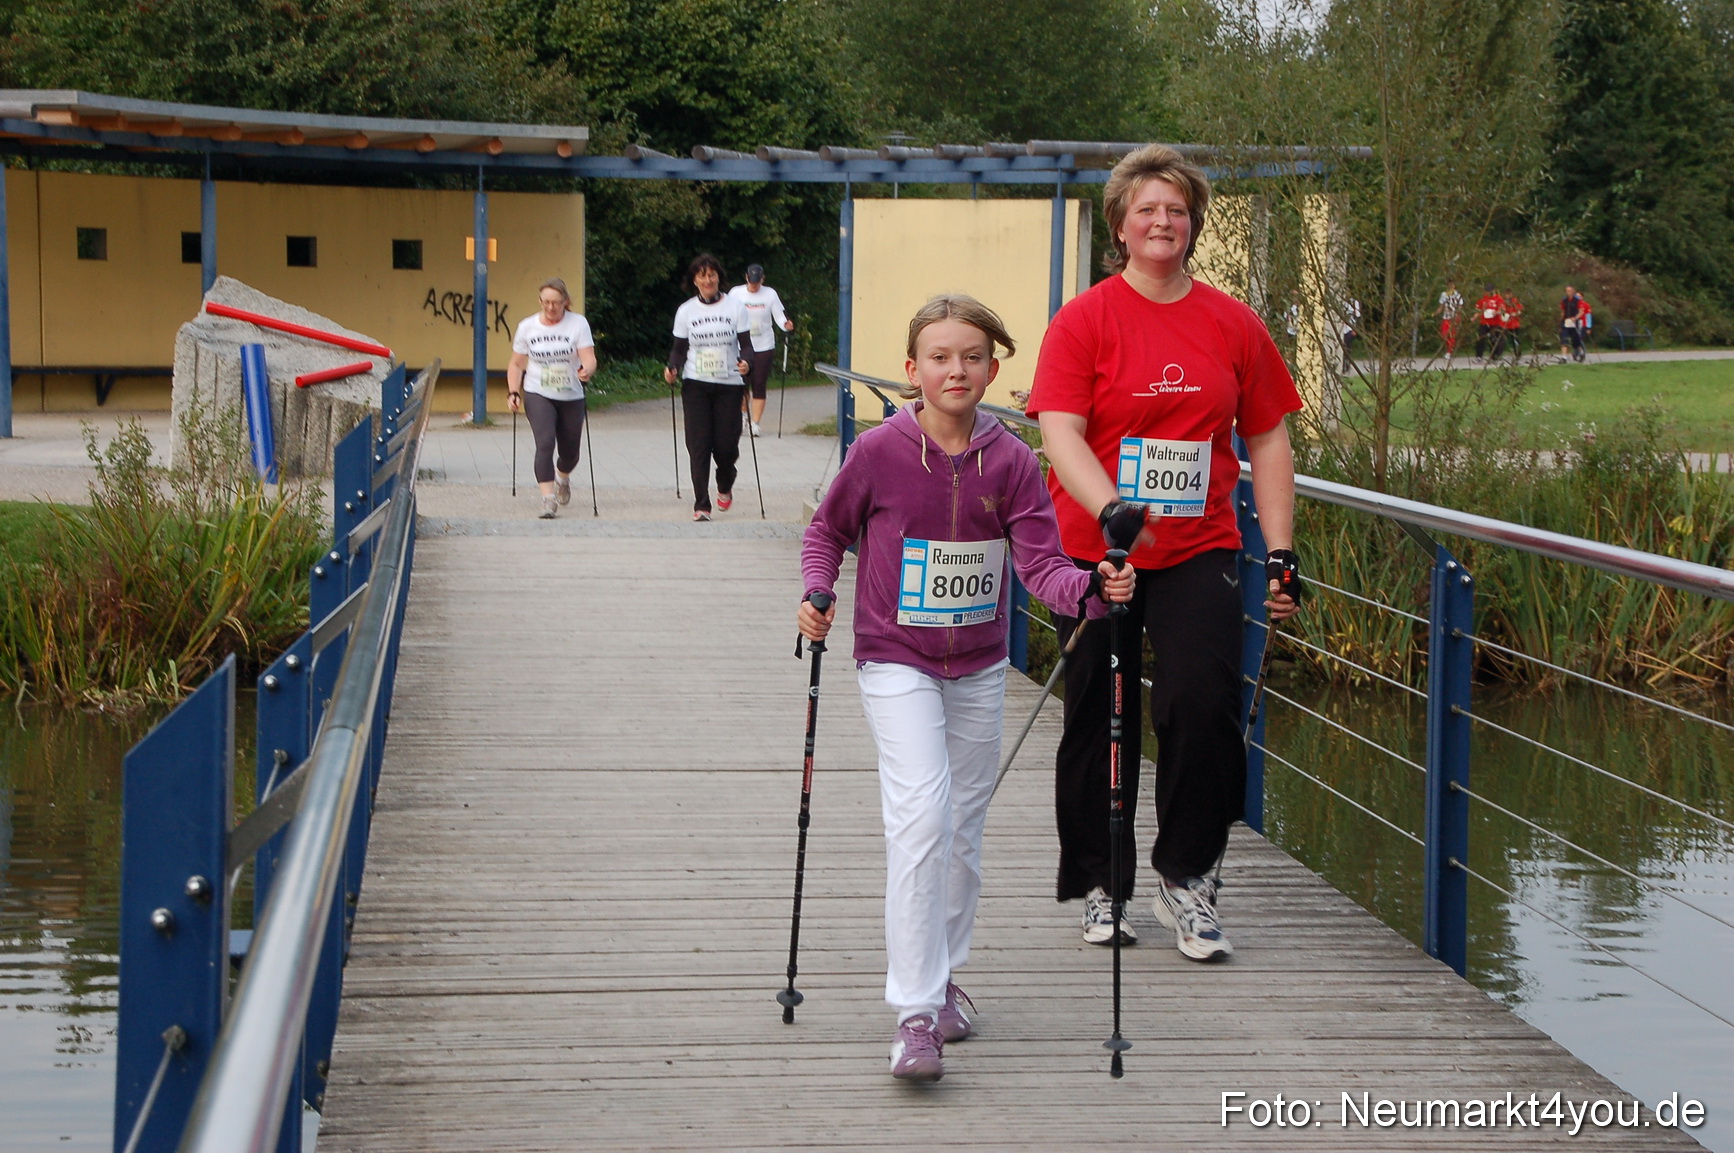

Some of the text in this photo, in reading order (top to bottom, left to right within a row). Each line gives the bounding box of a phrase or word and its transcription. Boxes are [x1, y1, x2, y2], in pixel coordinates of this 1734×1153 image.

[692, 315, 732, 327] BERGER
[530, 335, 570, 345] BERGER
[1146, 445, 1200, 462] Waltraud
[1145, 469, 1202, 491] 8004
[932, 548, 984, 565] Ramona
[932, 572, 994, 598] 8006
